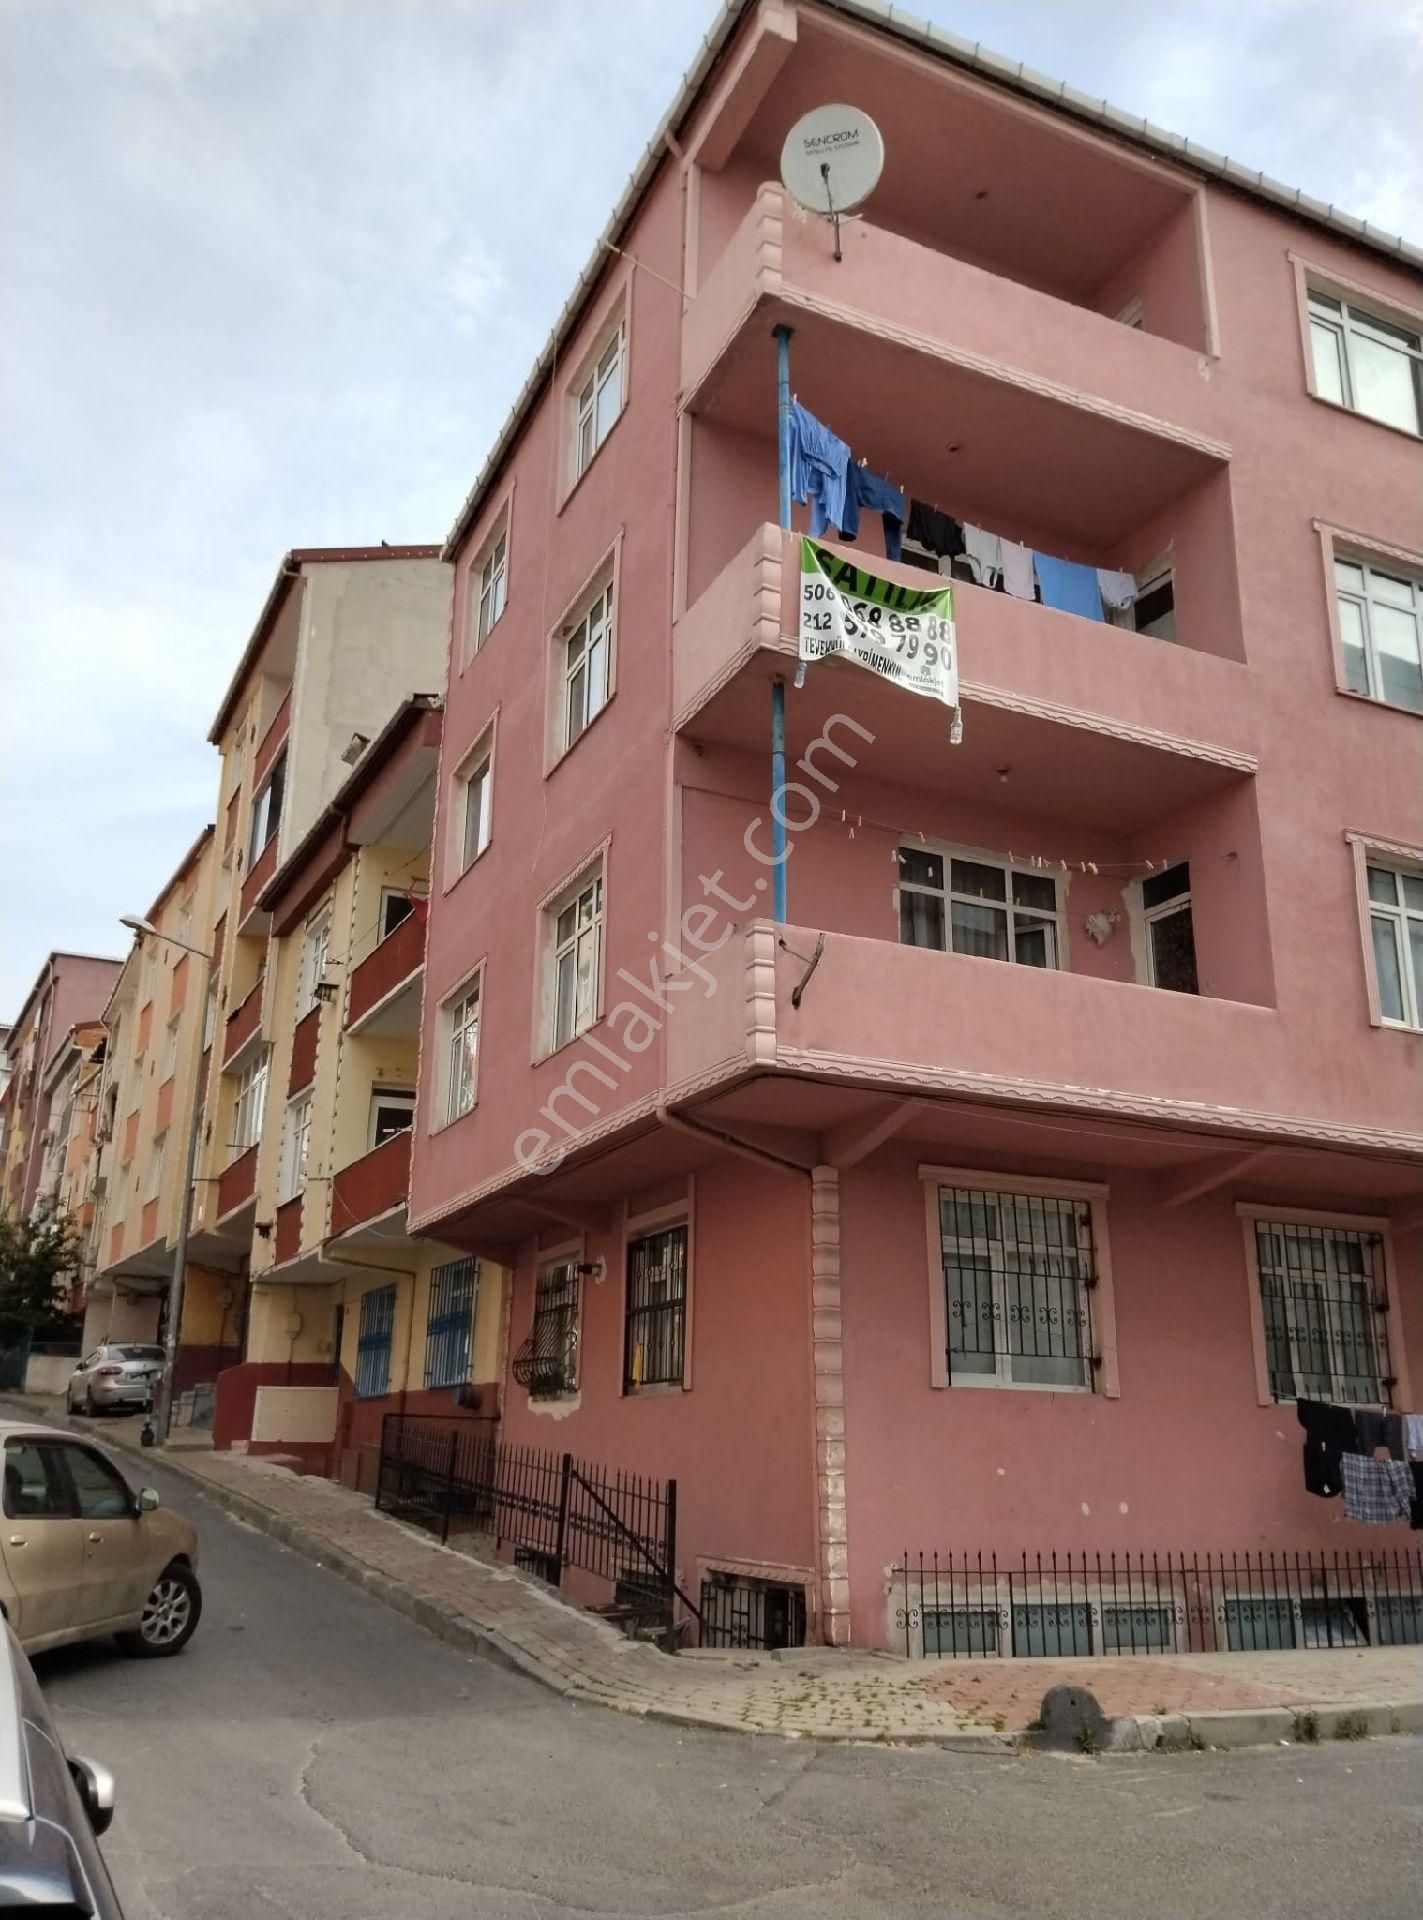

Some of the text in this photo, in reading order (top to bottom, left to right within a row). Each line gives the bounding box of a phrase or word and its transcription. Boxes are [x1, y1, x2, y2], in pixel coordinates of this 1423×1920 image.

[804, 128, 859, 149] SENCROM
[803, 584, 835, 601] 506
[803, 612, 832, 631] 212
[890, 634, 920, 660] 79
[924, 643, 951, 671] 90
